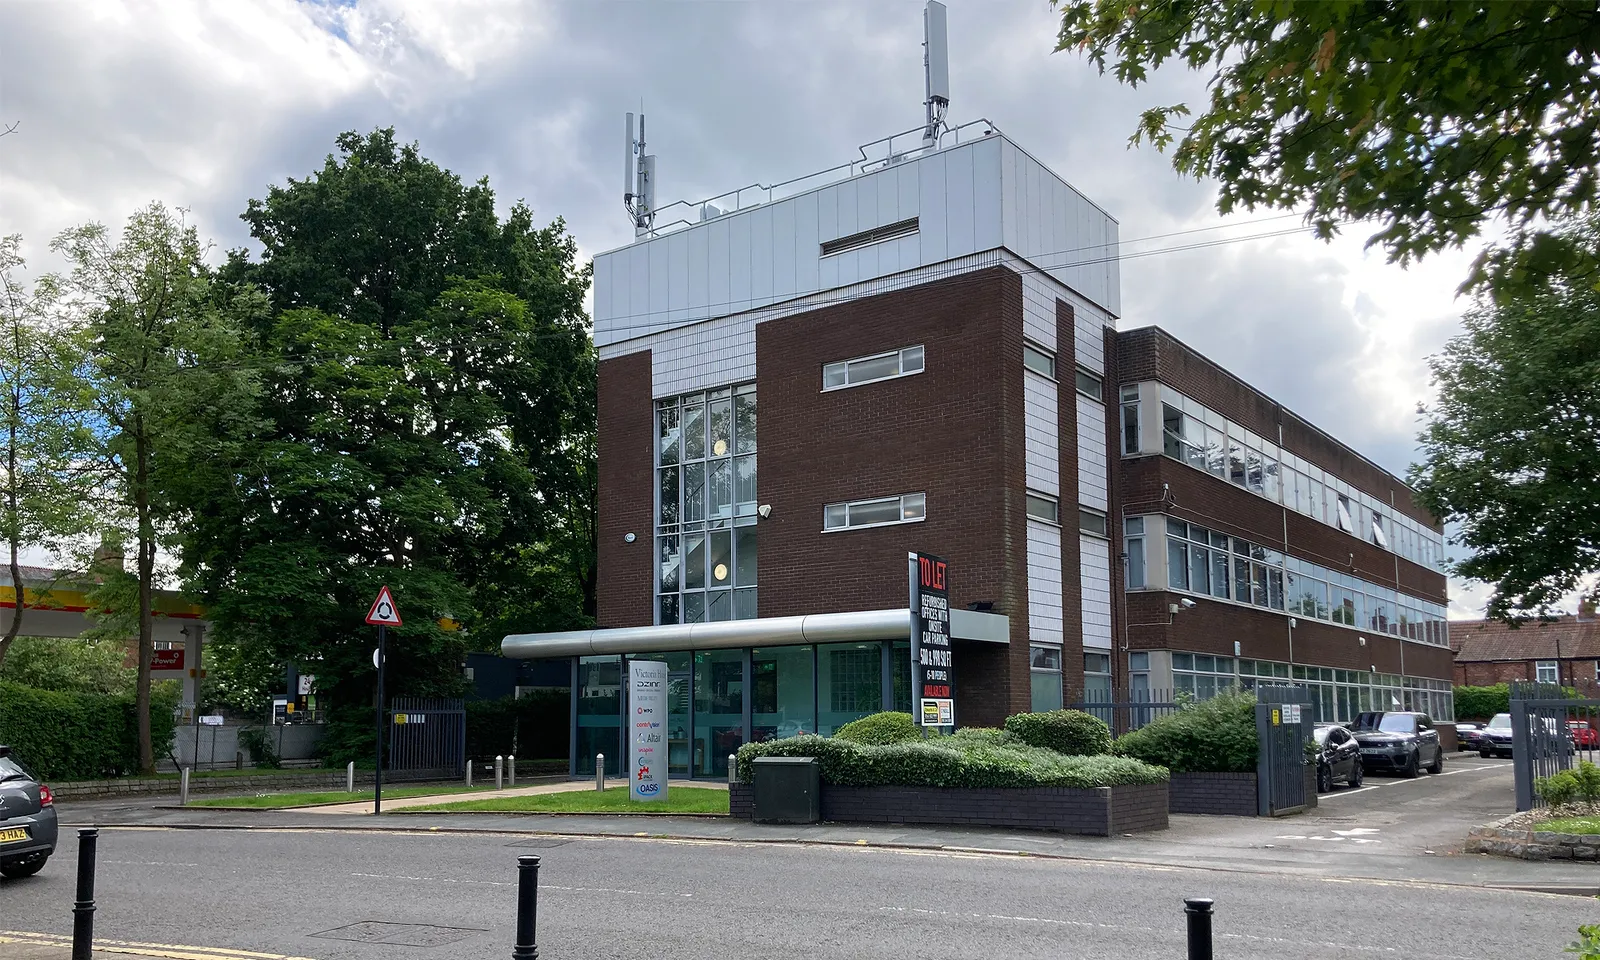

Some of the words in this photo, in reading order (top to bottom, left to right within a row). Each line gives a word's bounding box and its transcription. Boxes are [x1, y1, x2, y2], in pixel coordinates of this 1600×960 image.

[919, 557, 931, 587] TO
[932, 560, 947, 590] LET
[921, 594, 947, 610] REFURBISHED
[921, 606, 938, 620] OFFICES
[938, 609, 948, 622] WITH
[928, 619, 943, 633] ONSITE
[922, 631, 931, 644] CAR
[931, 632, 949, 646] PARKING
[635, 668, 657, 679] Victoria
[646, 732, 661, 743] Altair
[640, 783, 658, 793] OASIS
[7, 829, 25, 839] HAZ
